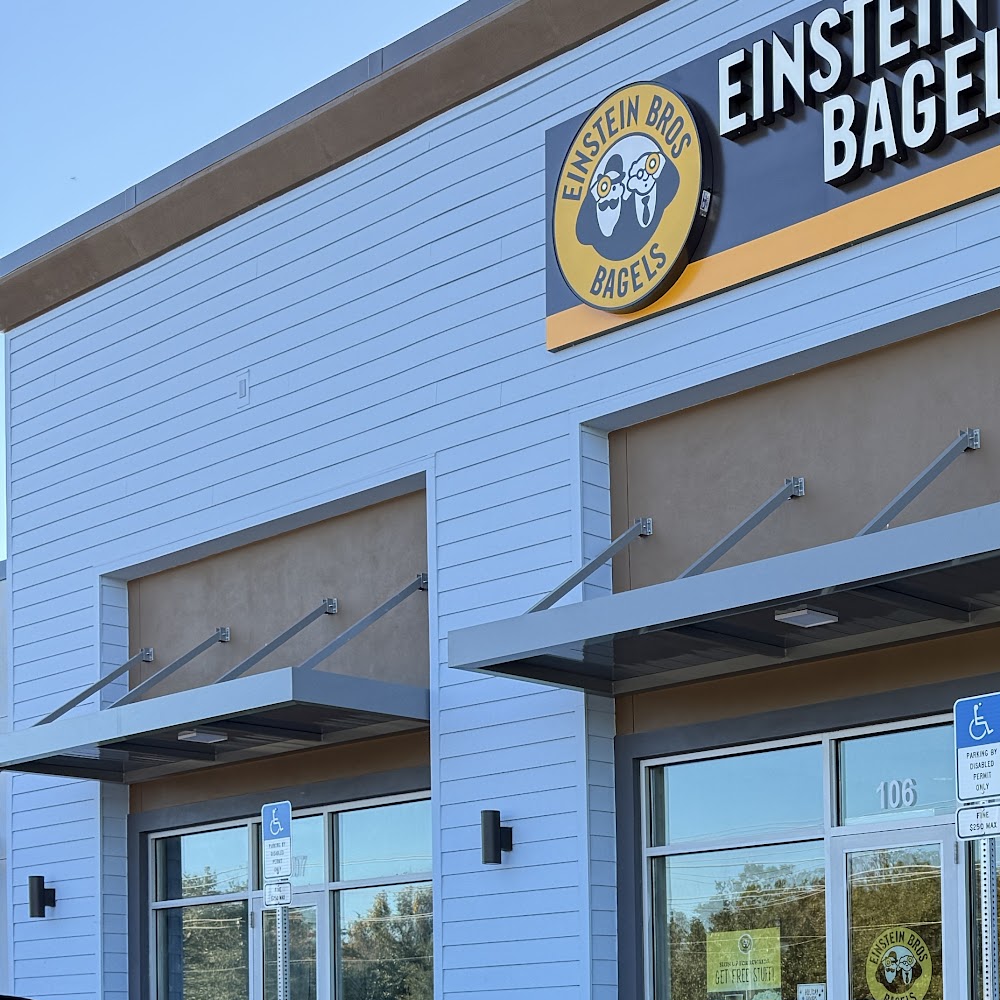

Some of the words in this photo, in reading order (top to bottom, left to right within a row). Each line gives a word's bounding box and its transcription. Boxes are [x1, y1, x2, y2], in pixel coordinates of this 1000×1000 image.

[562, 95, 640, 201] EINSTEIN
[645, 95, 692, 159] BROS
[590, 242, 667, 298] BAGELS
[966, 749, 989, 759] PARKING
[990, 748, 998, 756] BY
[969, 760, 995, 770] DISABLED
[973, 771, 992, 780] PERMIT
[876, 778, 916, 809] 106
[975, 783, 990, 791] ONLY
[869, 930, 906, 965] EINSTEIN
[907, 933, 928, 963] BROS
[715, 968, 729, 985] GET
[731, 967, 750, 984] FREE
